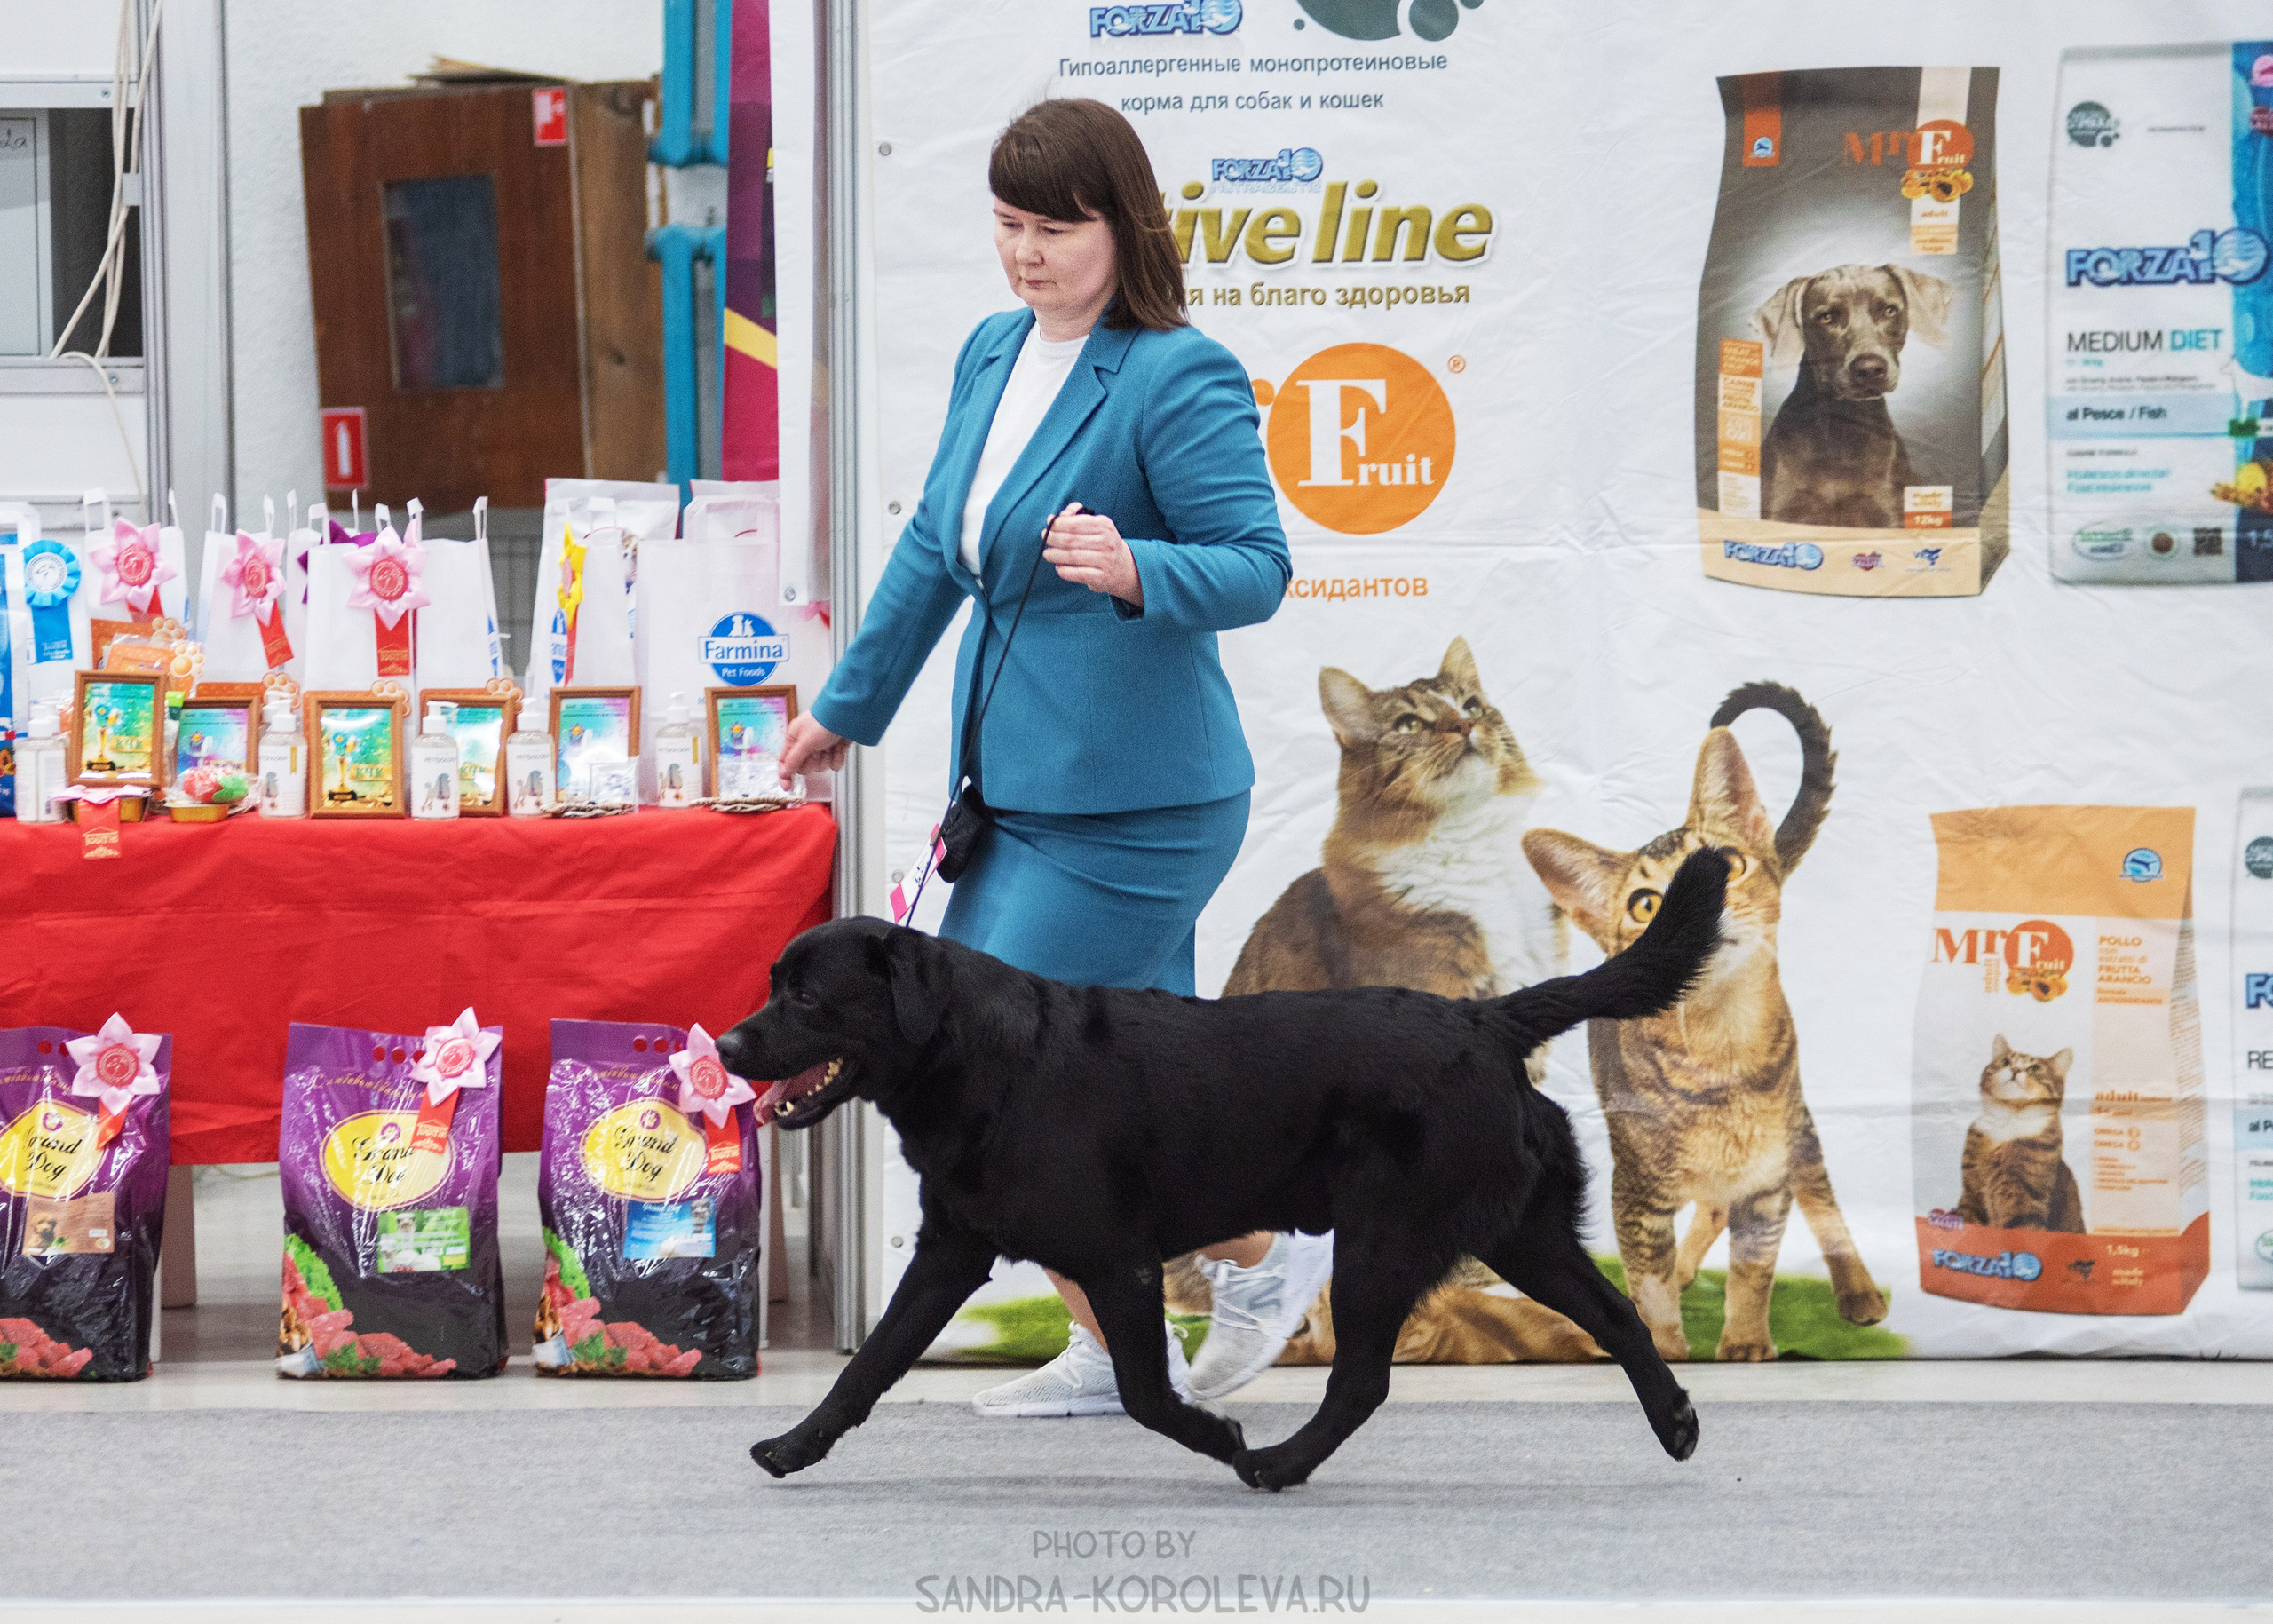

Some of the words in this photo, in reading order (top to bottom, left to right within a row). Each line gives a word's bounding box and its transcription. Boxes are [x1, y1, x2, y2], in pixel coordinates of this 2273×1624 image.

[1059, 58, 1241, 78] Гипоаллергенные
[1250, 54, 1448, 76] монопротеиновые
[1121, 94, 1183, 114] корма
[1191, 92, 1229, 112] для
[1235, 90, 1293, 110] собак
[1299, 93, 1312, 108] и
[1319, 91, 1384, 108] кошек
[1212, 147, 1323, 183] FORZA10
[1160, 181, 1301, 265] ive
[1312, 180, 1493, 265] line
[2066, 228, 2271, 288] FORZA10
[1213, 287, 1241, 305] на
[1250, 281, 1327, 306] благо
[1335, 284, 1470, 310] здоровья
[2067, 329, 2164, 353] MEDIUM
[2169, 328, 2223, 352] DIET
[2067, 408, 2079, 421] al
[2082, 407, 2125, 421] Pesce
[2139, 405, 2167, 421] Fish
[1295, 378, 1435, 487] Fruit
[705, 639, 783, 660] Farmina
[722, 667, 736, 677] Pet
[739, 666, 766, 678] Foods
[1932, 927, 2009, 965] Mr
[2013, 930, 2066, 970] Fruit
[2099, 936, 2142, 947] POLLO
[2098, 965, 2141, 974] FRUTTA
[2098, 975, 2153, 985] ARANCIO
[614, 1125, 679, 1153] Grand
[24, 1152, 67, 1182] Dog
[621, 1152, 664, 1182] Dog
[1932, 1249, 2042, 1281] FORZA10
